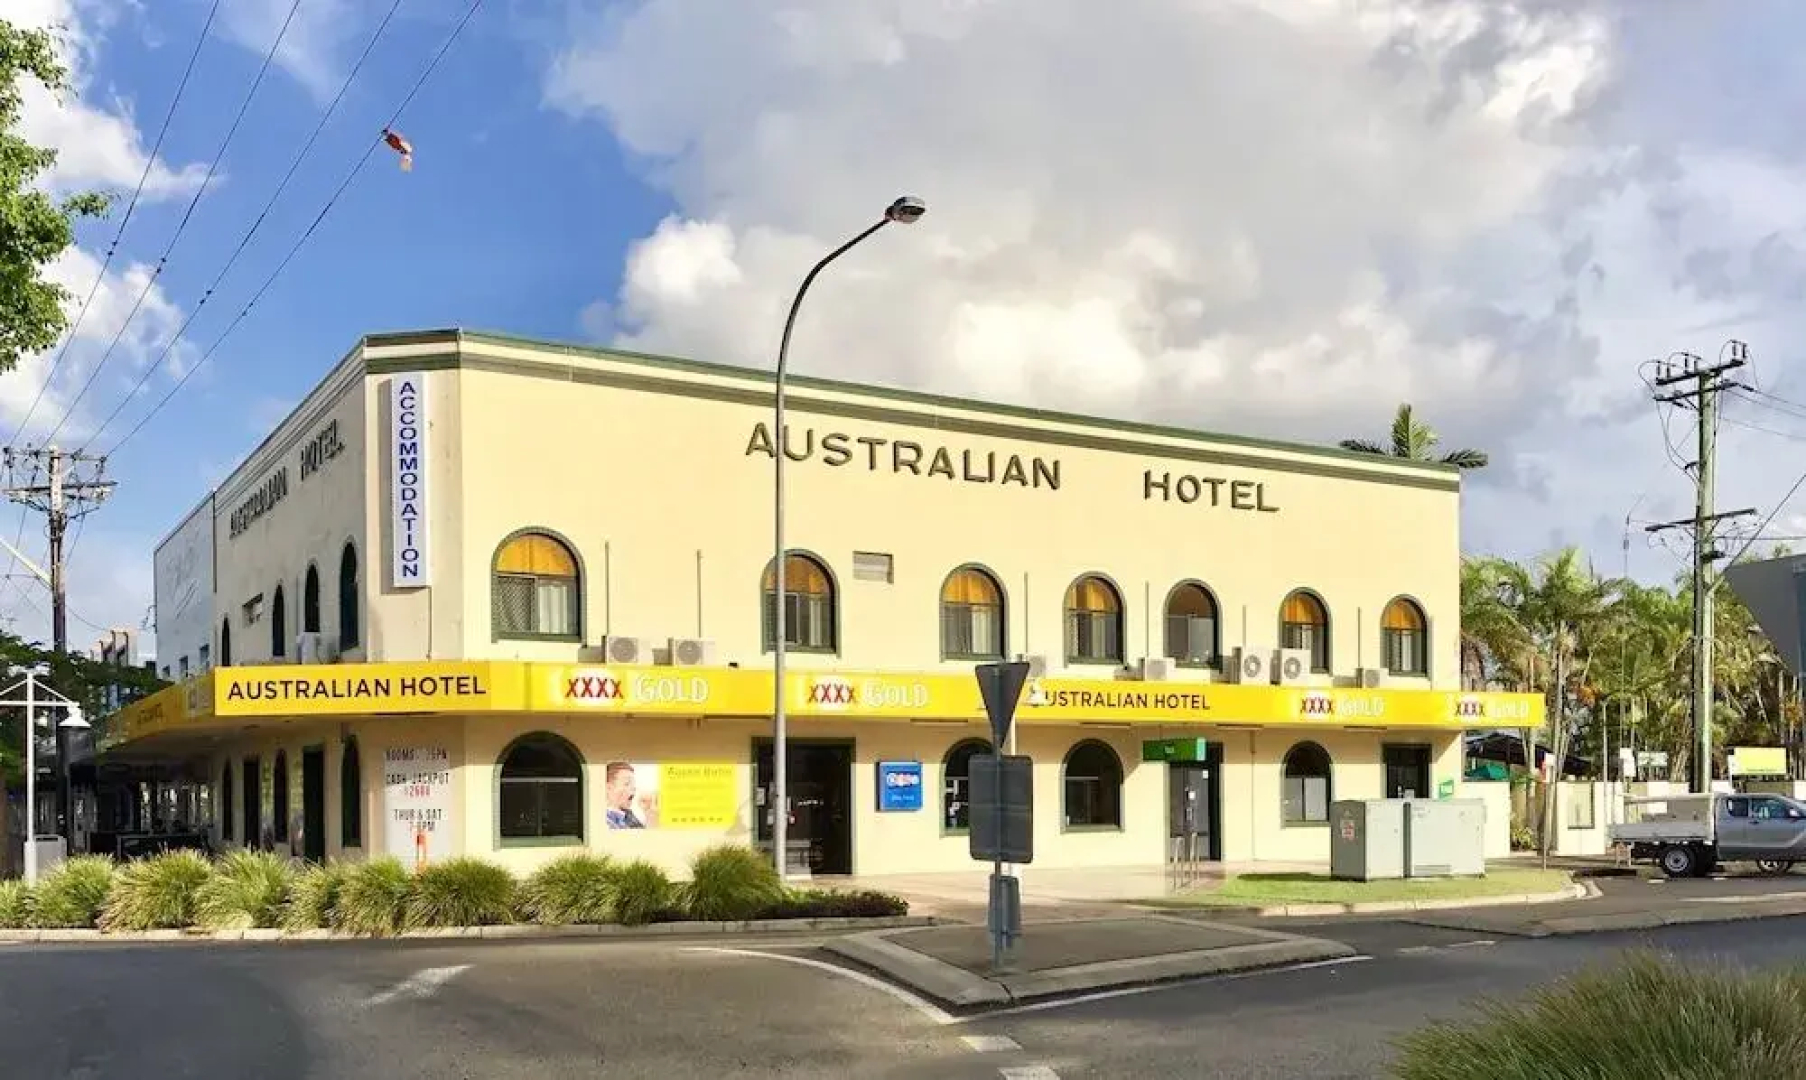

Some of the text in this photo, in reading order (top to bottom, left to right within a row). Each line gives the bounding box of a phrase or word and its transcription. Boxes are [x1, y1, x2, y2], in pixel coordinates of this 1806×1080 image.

[301, 418, 346, 482] HOTEL
[399, 380, 419, 578] ACCOMMODATION
[745, 422, 1280, 513] AUSTRALIAN HOTEL
[228, 678, 391, 700] AUSTRALIAN
[400, 676, 487, 696] HOTEL
[565, 674, 709, 704] XXXX GOLD
[808, 678, 930, 709] XXXX GOLD
[1155, 693, 1211, 711] HOTEL
[1300, 696, 1333, 715] XXXX
